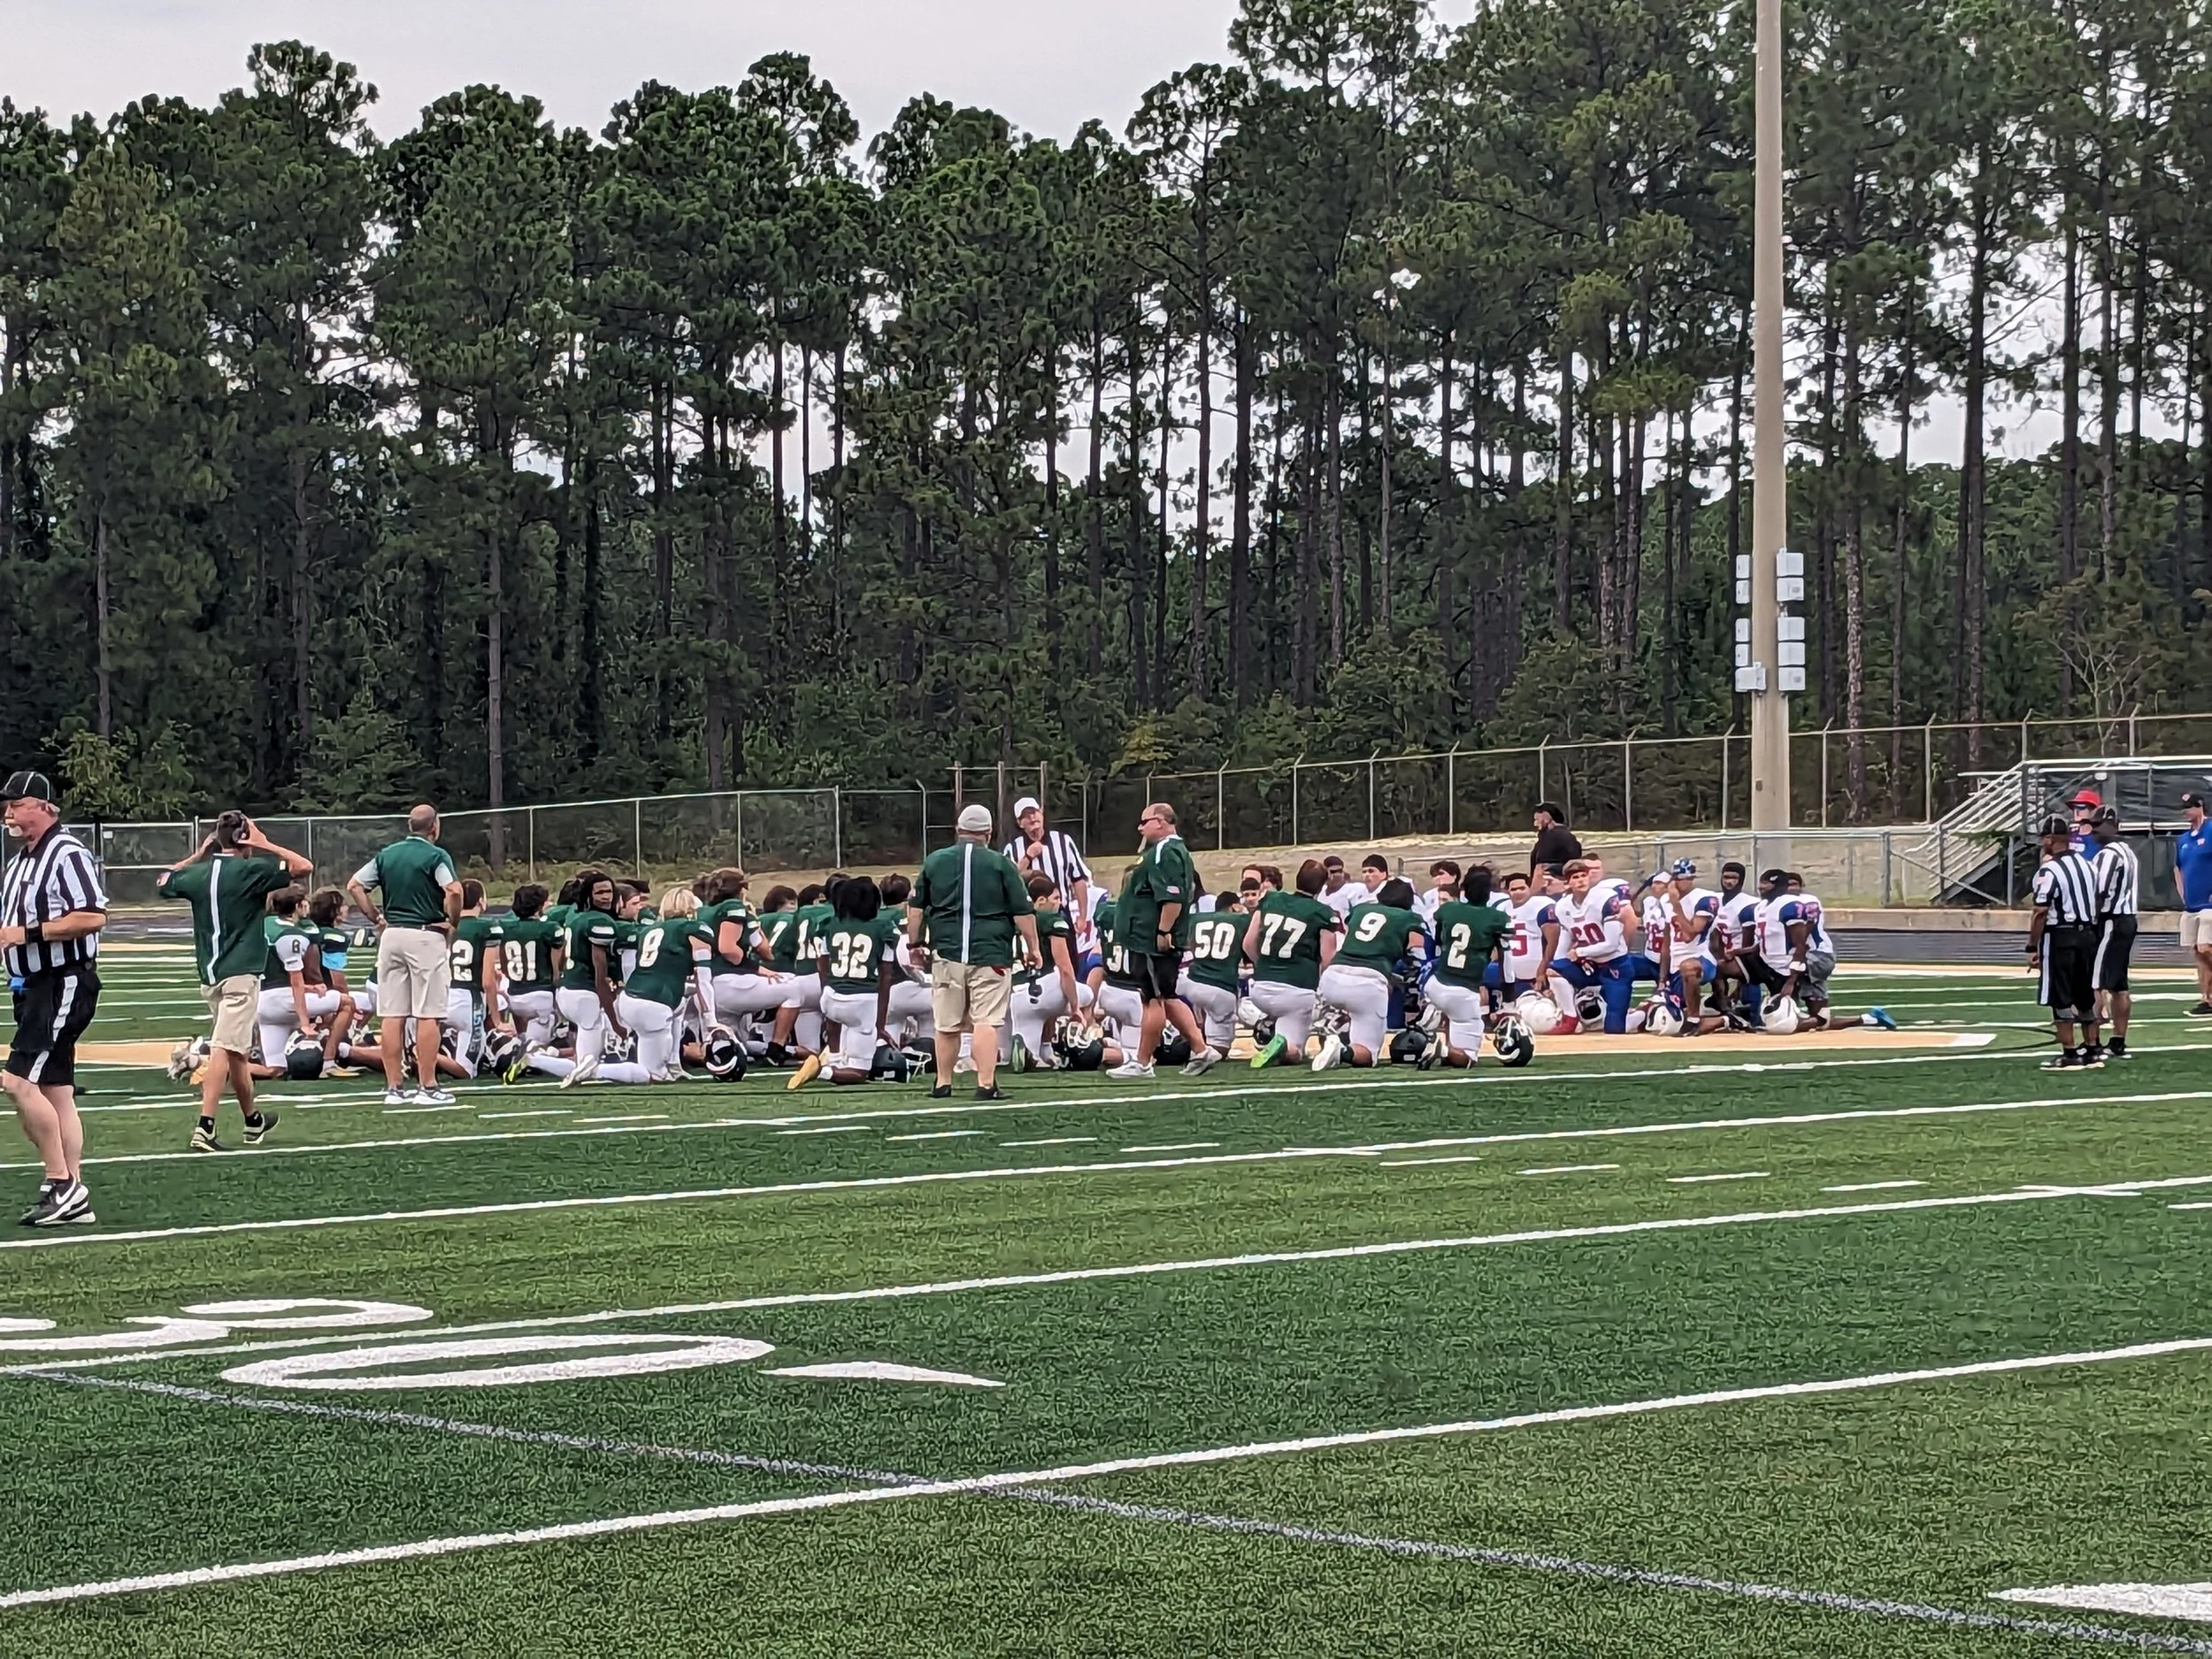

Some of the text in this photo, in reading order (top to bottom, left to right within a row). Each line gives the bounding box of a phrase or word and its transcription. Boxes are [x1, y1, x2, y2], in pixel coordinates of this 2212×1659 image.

[639, 928, 664, 967] 8
[1194, 920, 1235, 960] 50
[1259, 913, 1308, 958] 77
[1355, 912, 1387, 942] 9
[1447, 923, 1471, 969] 2
[831, 932, 872, 979] 32
